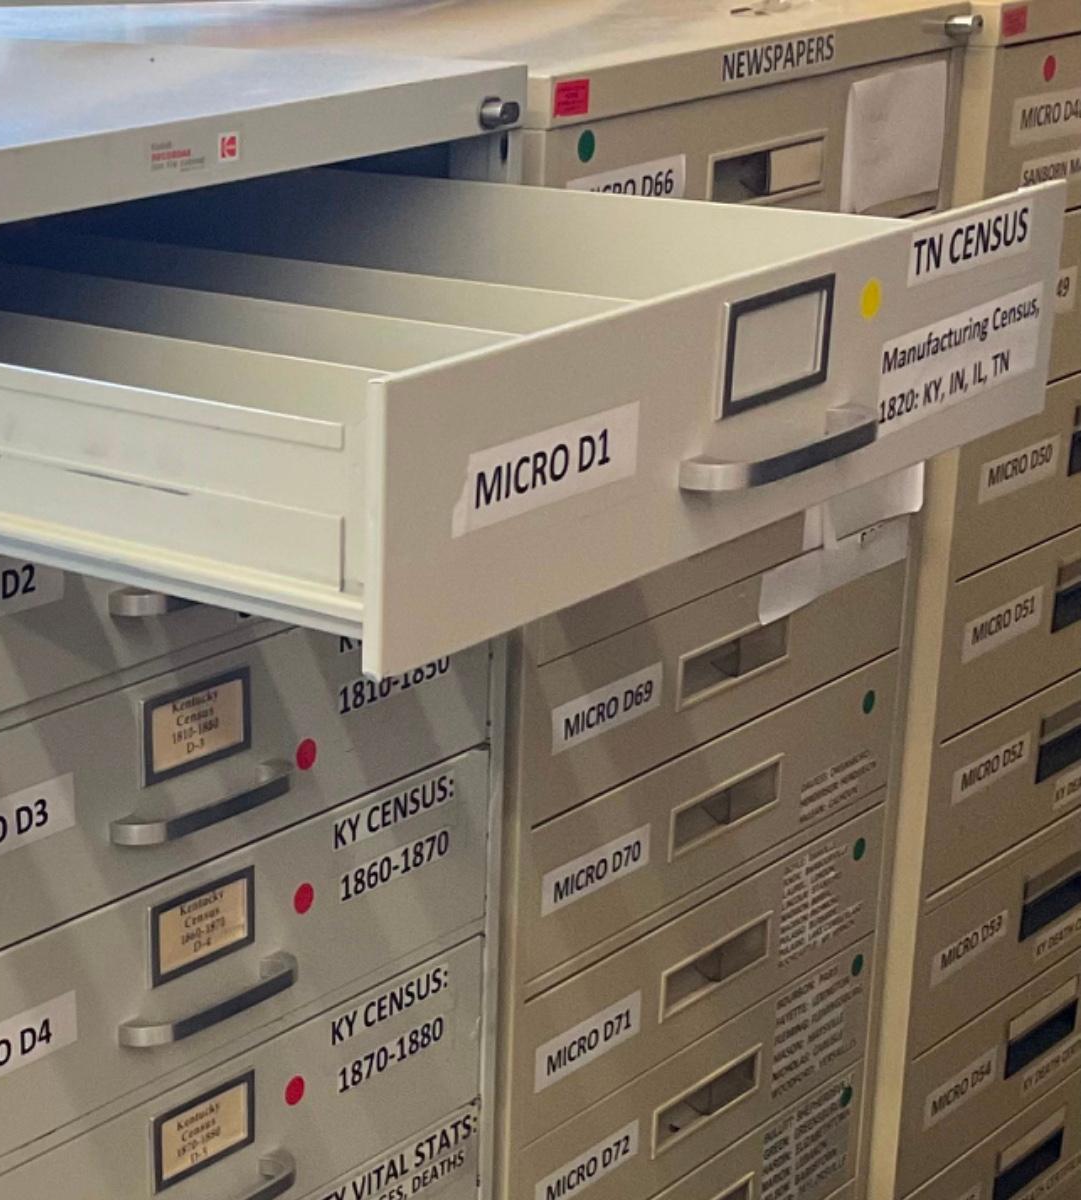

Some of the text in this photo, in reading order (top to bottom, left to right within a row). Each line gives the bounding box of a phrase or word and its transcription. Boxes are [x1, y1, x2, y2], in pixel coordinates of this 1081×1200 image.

[722, 34, 835, 82] NEWSPAPERS
[1020, 102, 1062, 130] MICRO
[641, 168, 674, 197] D66
[914, 207, 1030, 275] TN CENSUS
[882, 298, 1040, 374] Manufacturing Census,
[878, 349, 1011, 425] 1820: KY, IN, IL, TN
[475, 428, 611, 510] MICRO D1
[988, 444, 1053, 487] MICRO D50
[2, 564, 36, 600] D2
[972, 596, 1035, 644] MICRO D51
[563, 680, 653, 740] MICRO D69
[960, 741, 1024, 792] MICRO D52
[16, 799, 48, 835] D3
[334, 776, 454, 849] KY CENSUS:
[341, 830, 449, 901] 1860-1870
[553, 840, 641, 904] MICRO D70
[940, 915, 1003, 970] MICRO D53
[331, 967, 448, 1046] KY CENSUS:
[20, 1018, 52, 1056] D4
[338, 1016, 444, 1093] 1870-1880
[546, 1009, 632, 1076] MICRO D71
[930, 1077, 968, 1116] MICRO
[352, 1152, 409, 1200] VITAL
[414, 1114, 478, 1169] STATS:
[412, 1150, 465, 1193] DEATHS
[602, 1135, 630, 1169] D72
